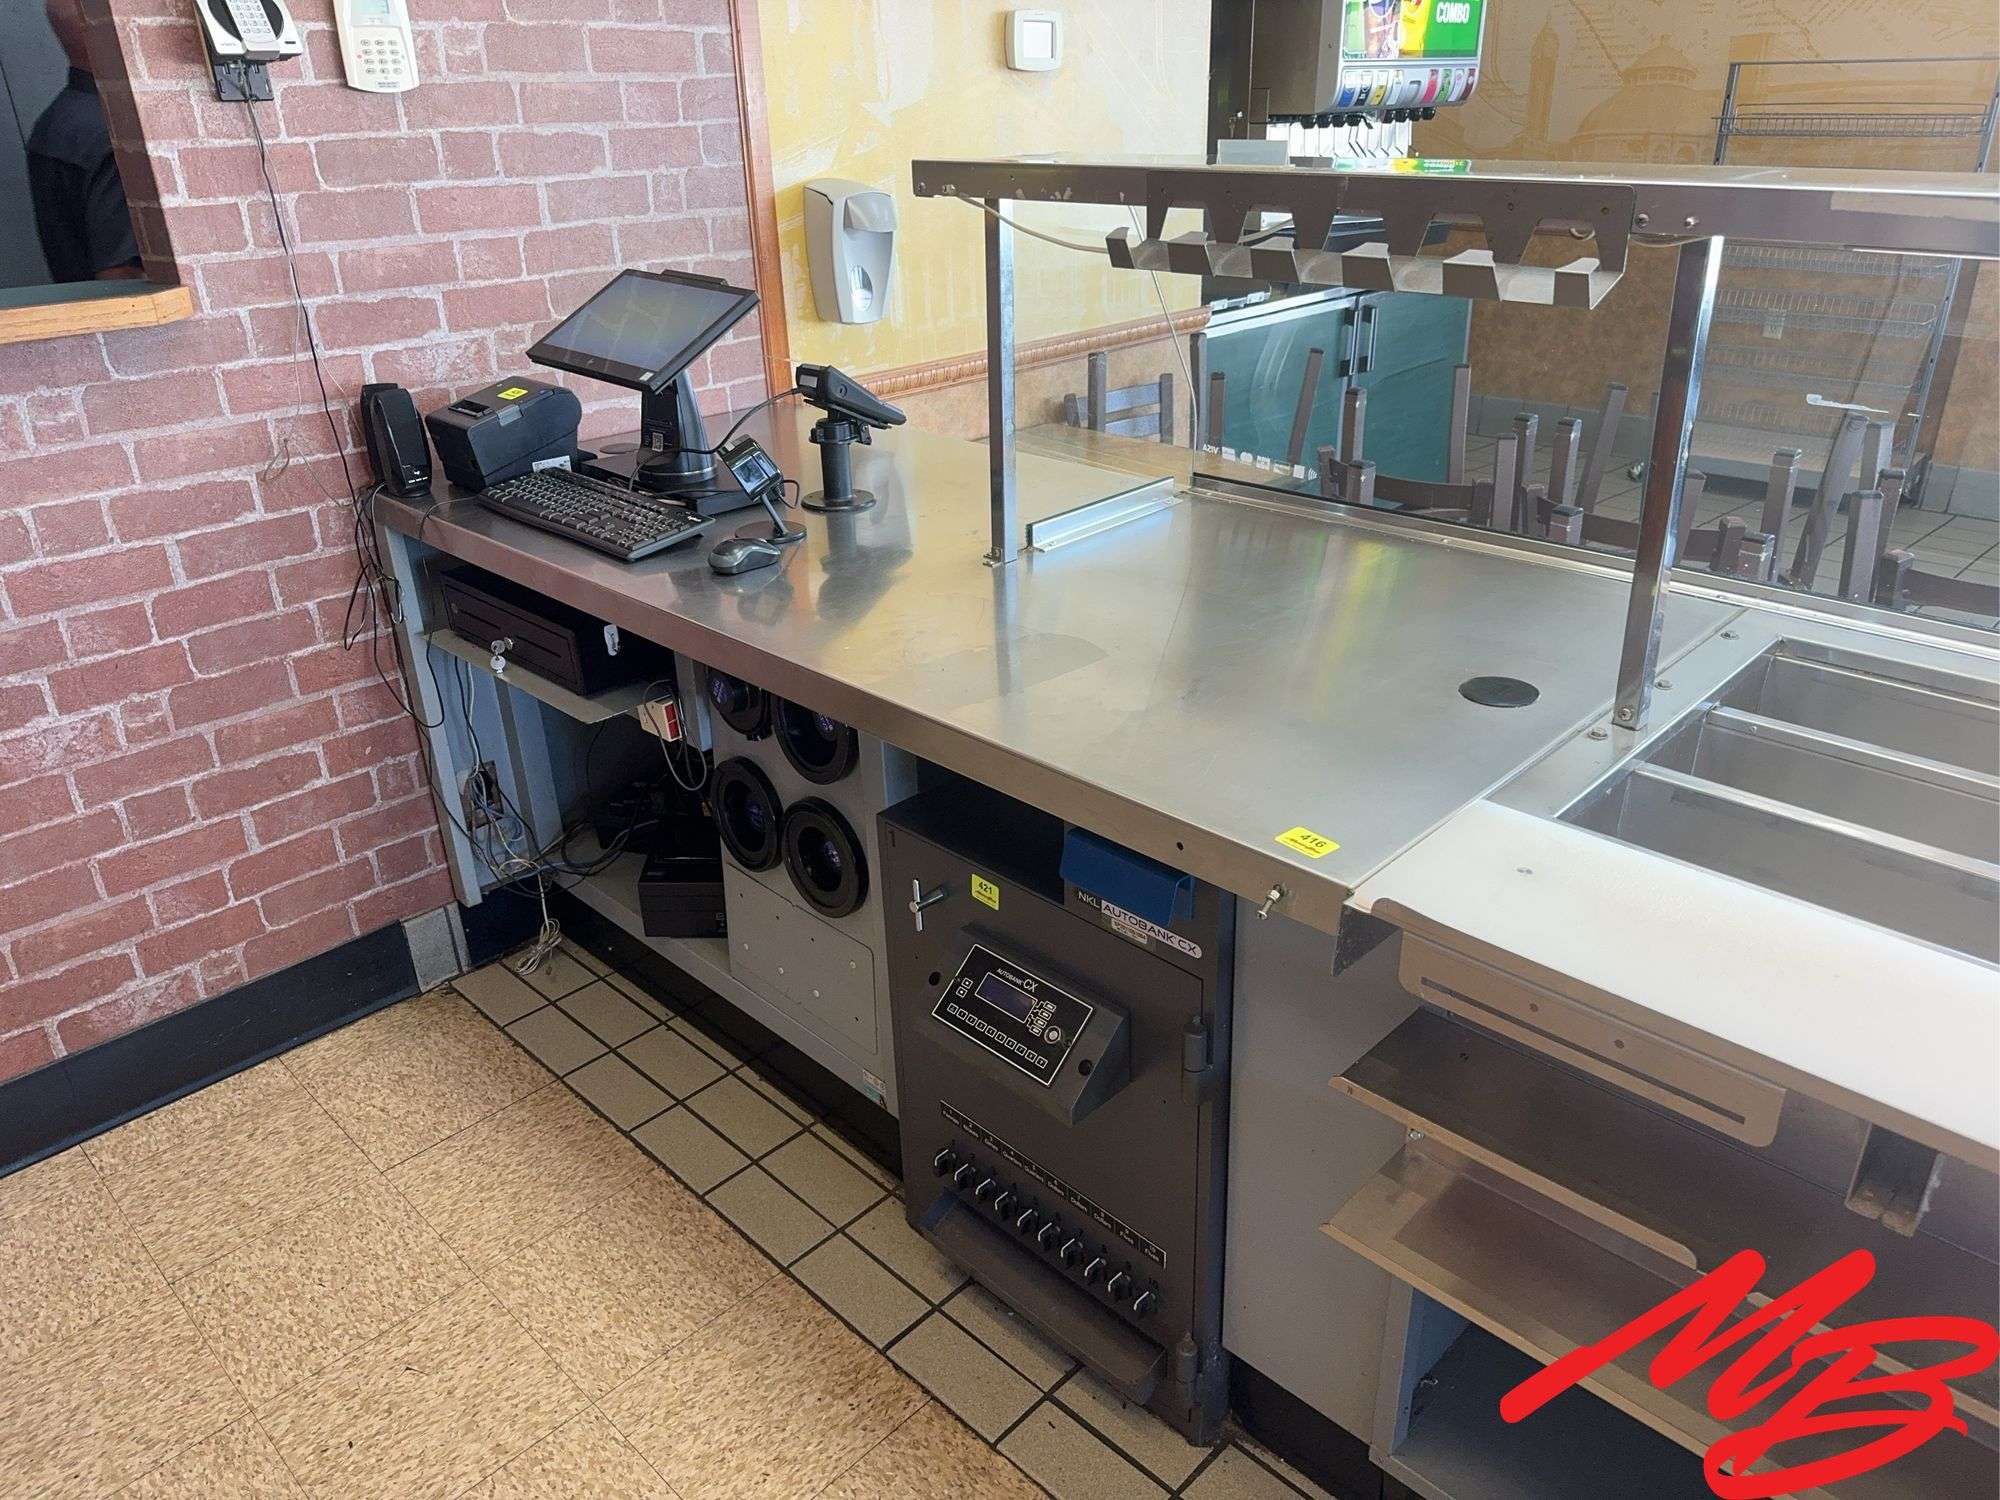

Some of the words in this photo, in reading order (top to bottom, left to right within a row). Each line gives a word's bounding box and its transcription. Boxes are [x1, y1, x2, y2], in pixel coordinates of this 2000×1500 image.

[1436, 2, 1471, 24] COMBO
[1300, 834, 1327, 849] 416
[978, 881, 993, 895] 421
[1078, 890, 1101, 909] NKL
[1103, 903, 1177, 944] AUTOBANK
[1177, 938, 1198, 957] CX
[996, 967, 1022, 986] AUTOBANK
[1023, 978, 1040, 993] CX
